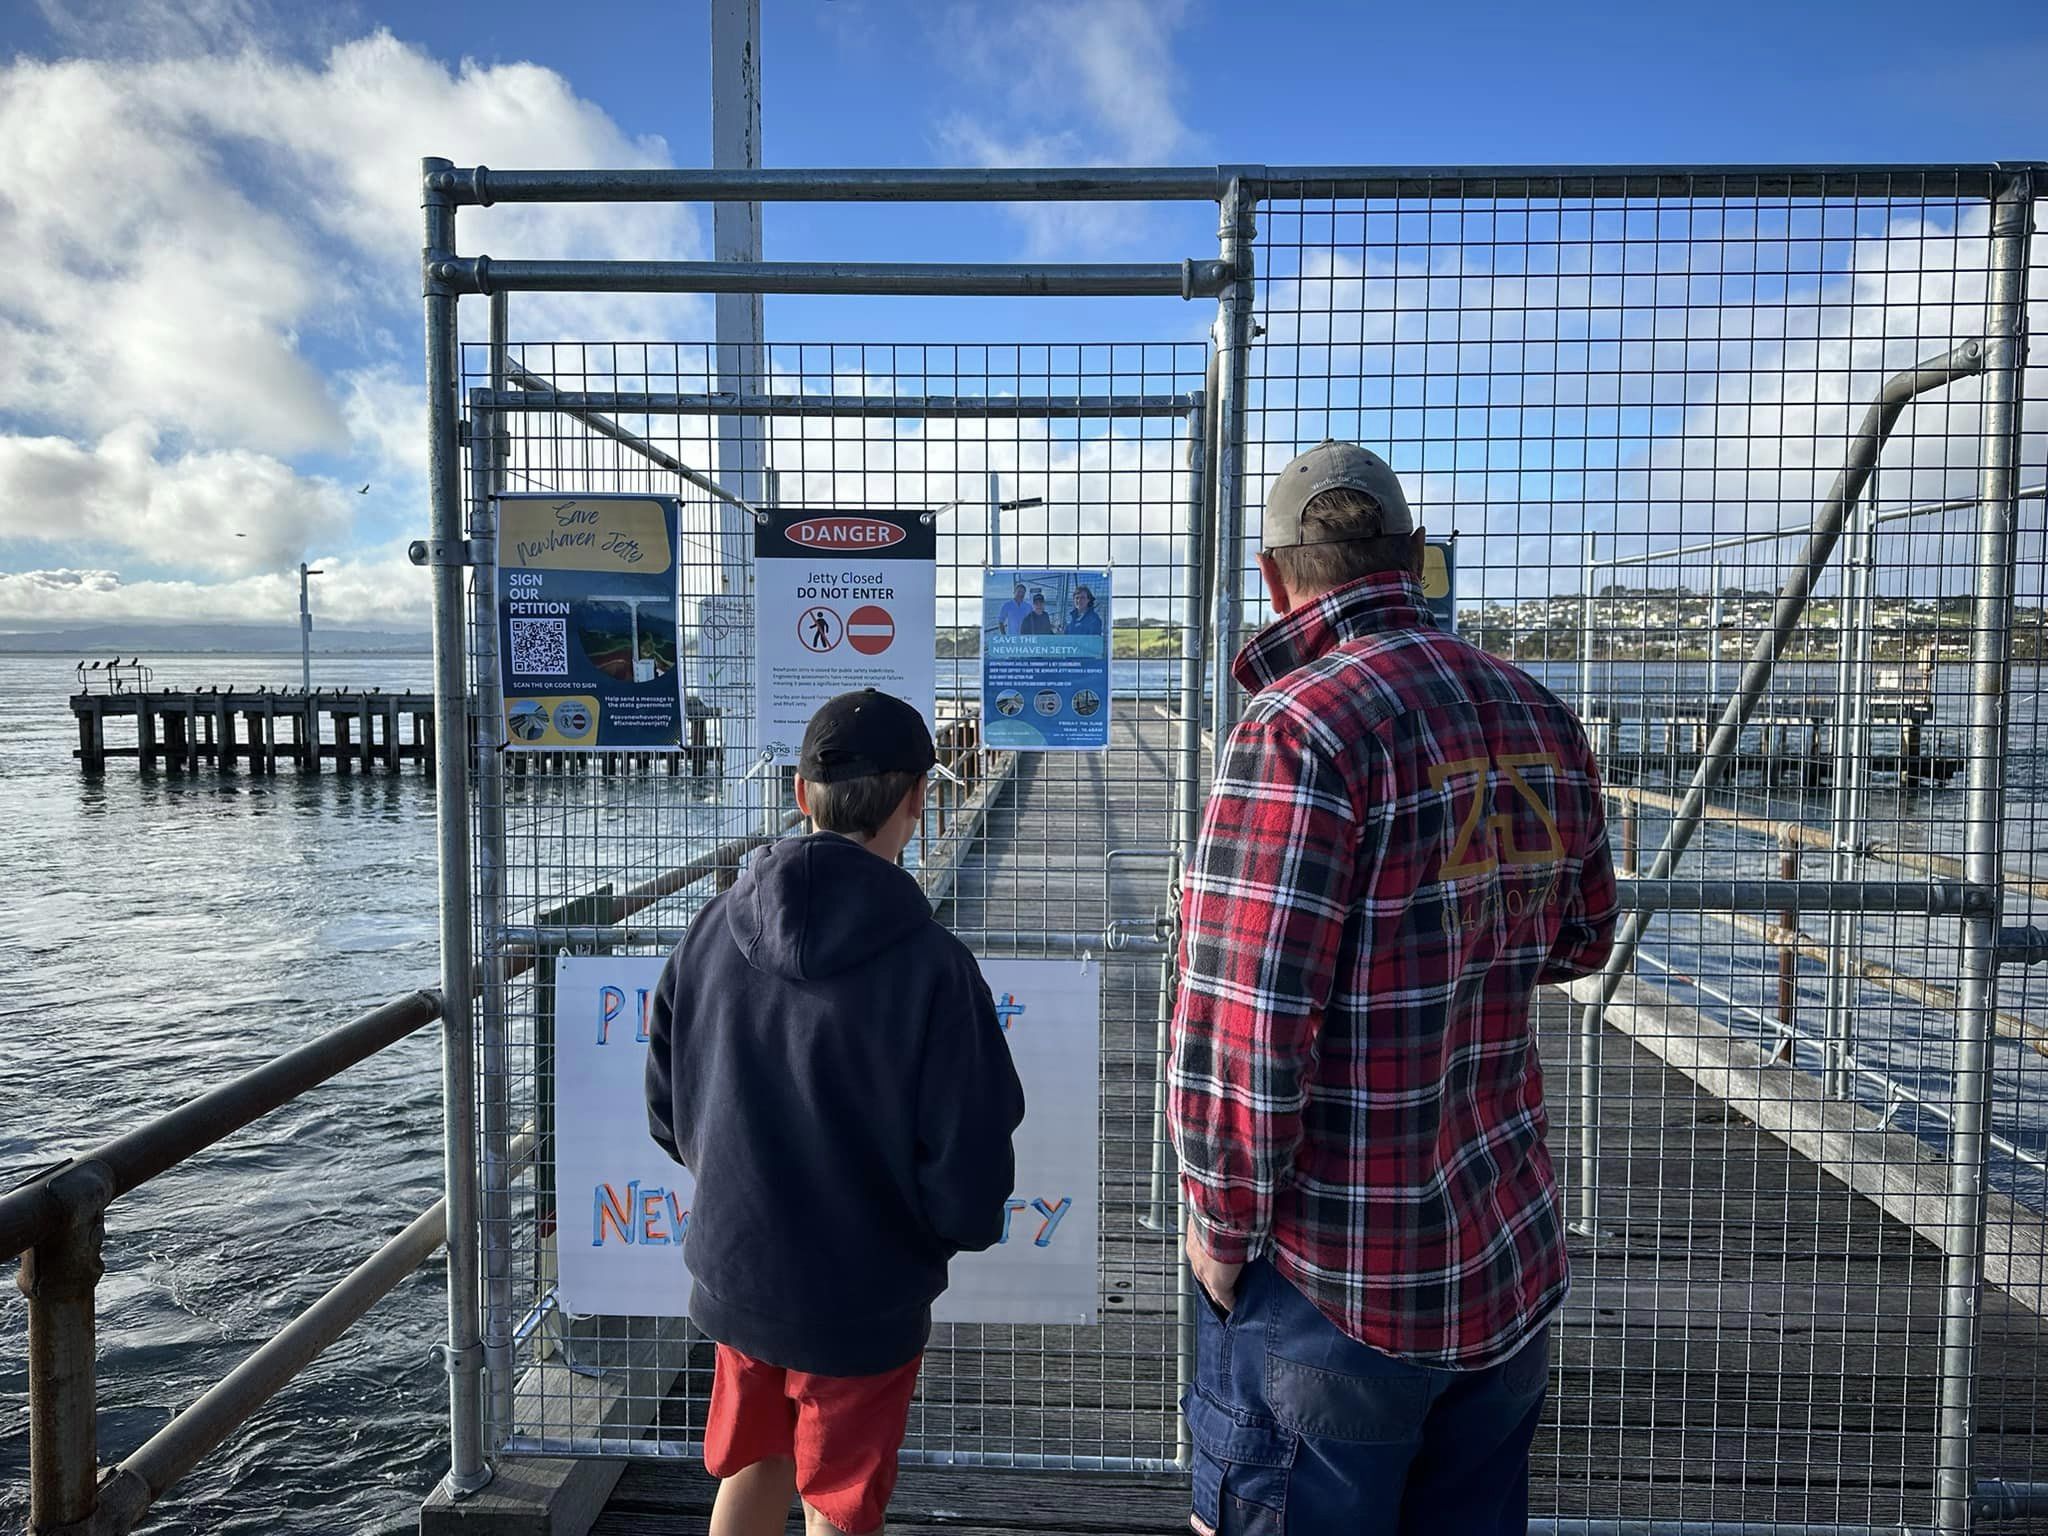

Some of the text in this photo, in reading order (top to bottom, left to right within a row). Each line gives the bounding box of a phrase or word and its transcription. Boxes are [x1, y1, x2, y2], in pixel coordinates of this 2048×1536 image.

[552, 501, 599, 527] Save
[801, 525, 891, 542] DANGER
[517, 529, 644, 566] Newhaven Jetty
[509, 574, 543, 586] SIGN
[807, 572, 883, 586] Jetty Closed
[509, 588, 539, 600] OUR
[797, 587, 894, 600] DO NOT ENTER
[509, 602, 570, 615] PETITION
[992, 636, 1017, 644] SAVE
[992, 646, 1048, 655] NEWHAVEN
